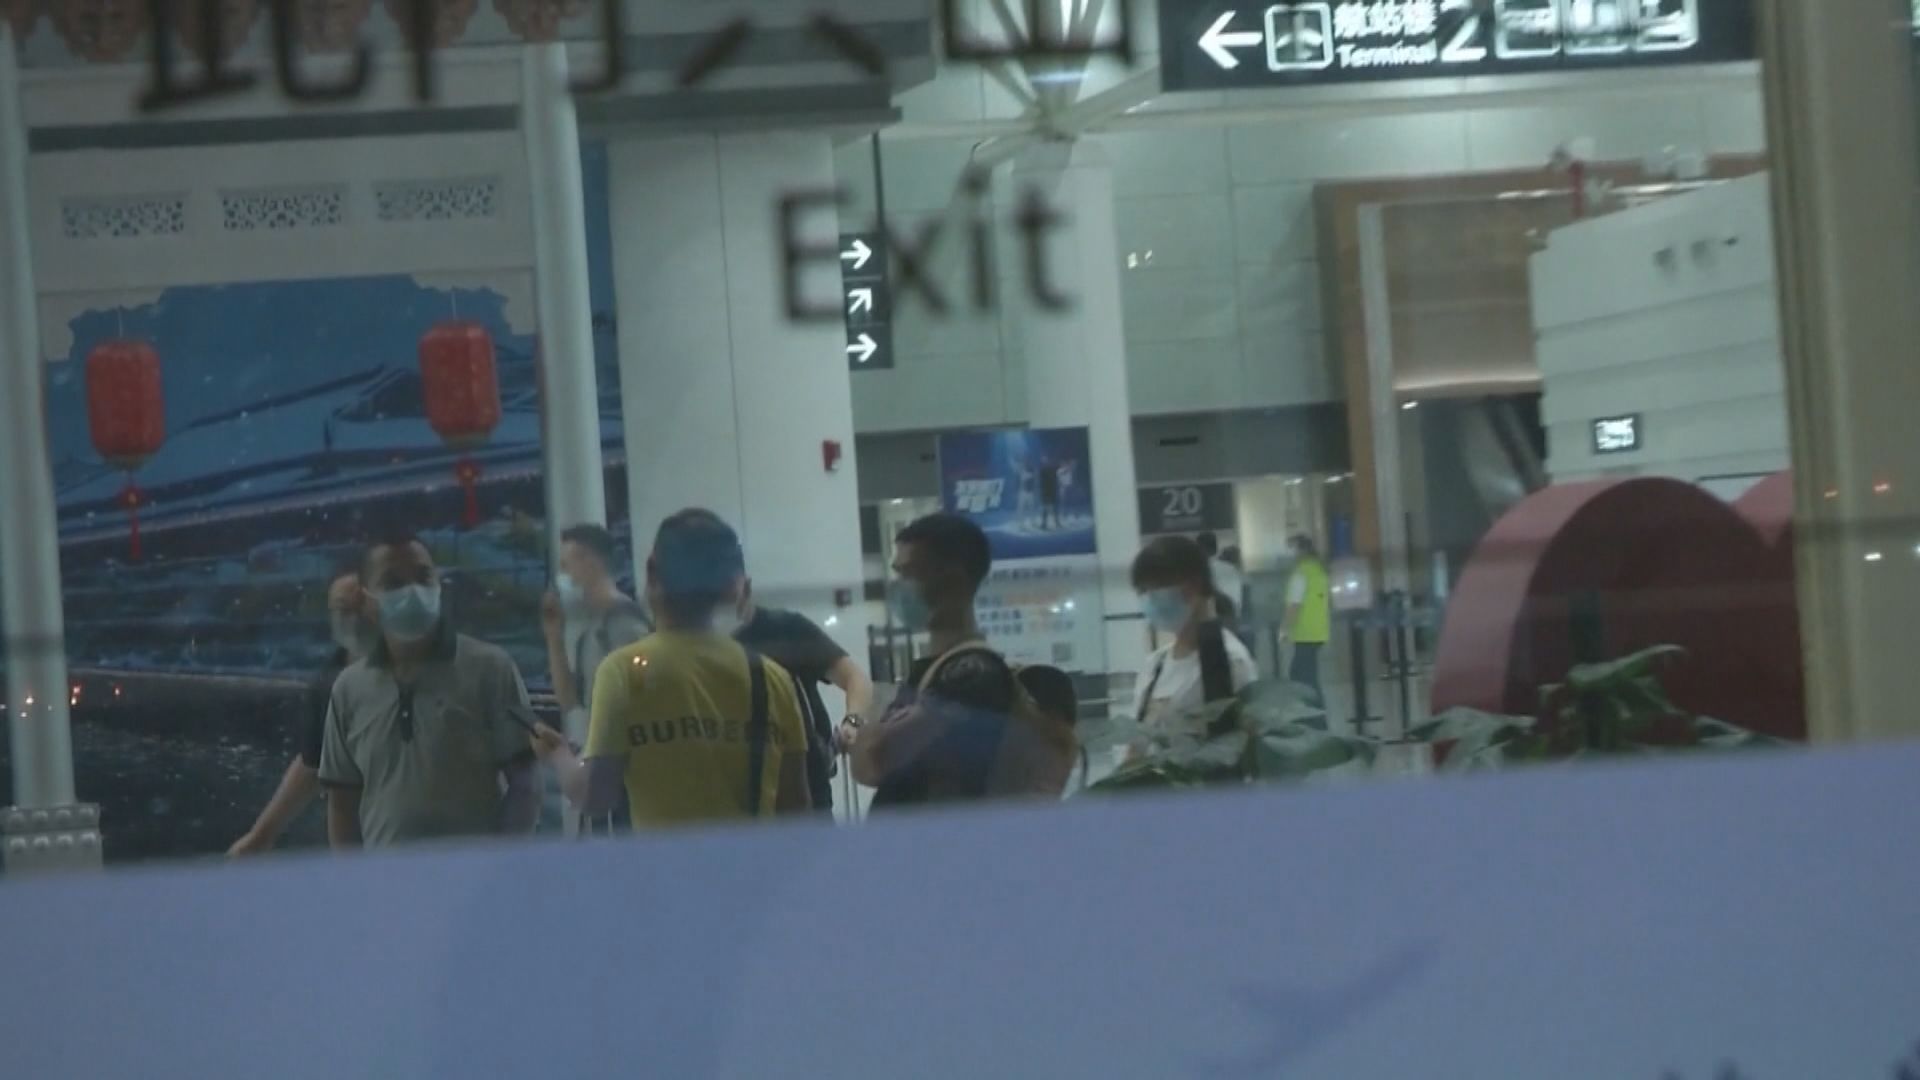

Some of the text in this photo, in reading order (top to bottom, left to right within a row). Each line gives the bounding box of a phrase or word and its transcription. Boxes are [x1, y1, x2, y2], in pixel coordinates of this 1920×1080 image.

[1335, 0, 1487, 69] Terminal 2
[776, 172, 1076, 324] Exit
[1162, 487, 1202, 516] 20
